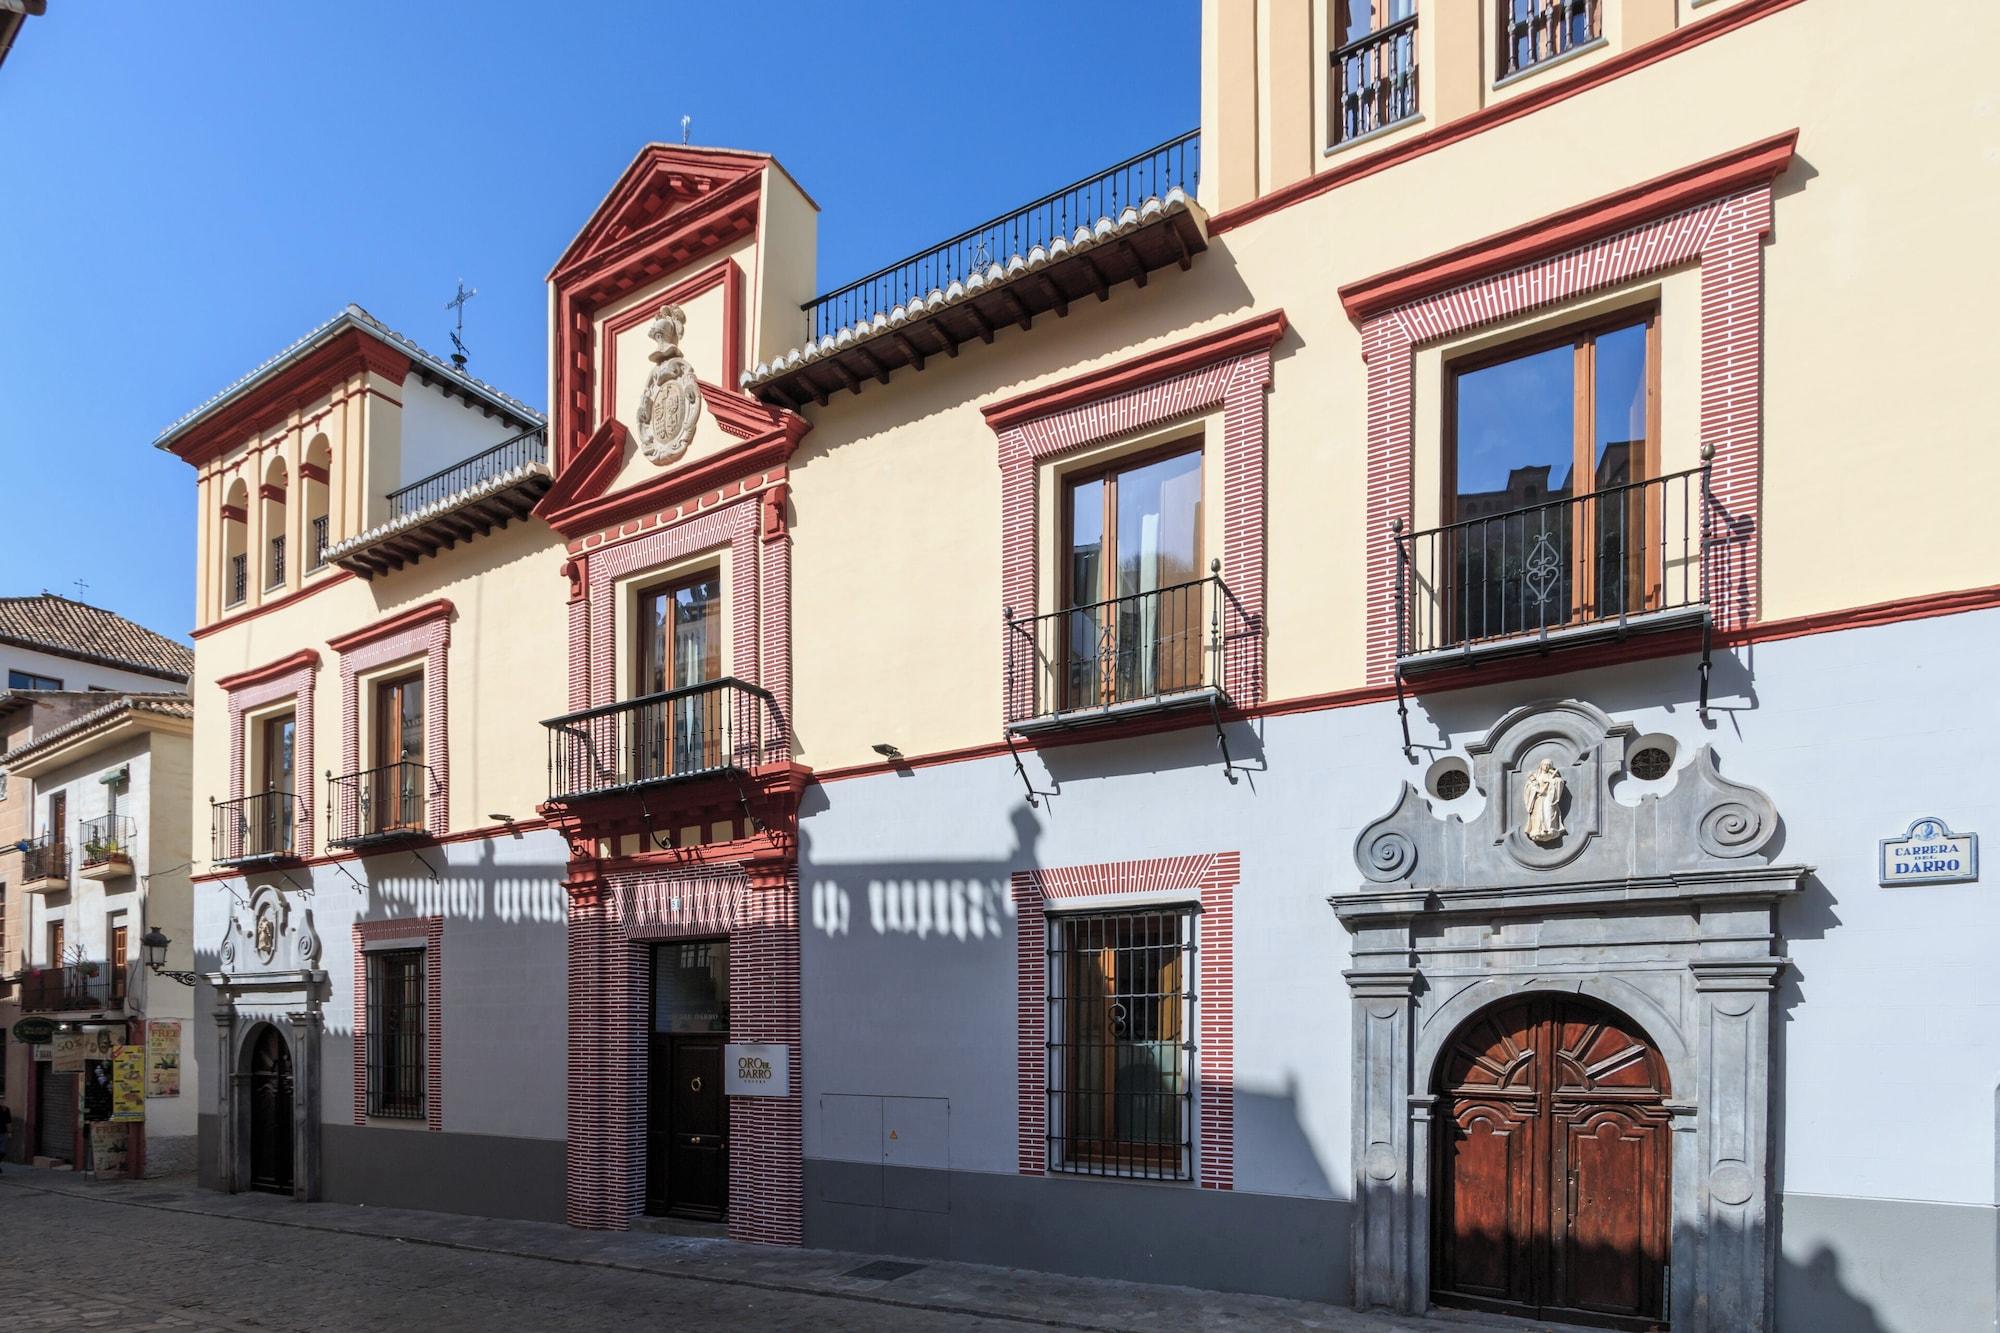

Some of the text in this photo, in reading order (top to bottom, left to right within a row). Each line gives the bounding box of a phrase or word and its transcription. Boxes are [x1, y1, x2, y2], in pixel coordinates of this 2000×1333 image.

[1895, 844, 1960, 856] CARRERA
[1895, 859, 1960, 874] DARRO
[738, 1057, 762, 1069] ORO
[738, 1068, 772, 1079] DARRO
